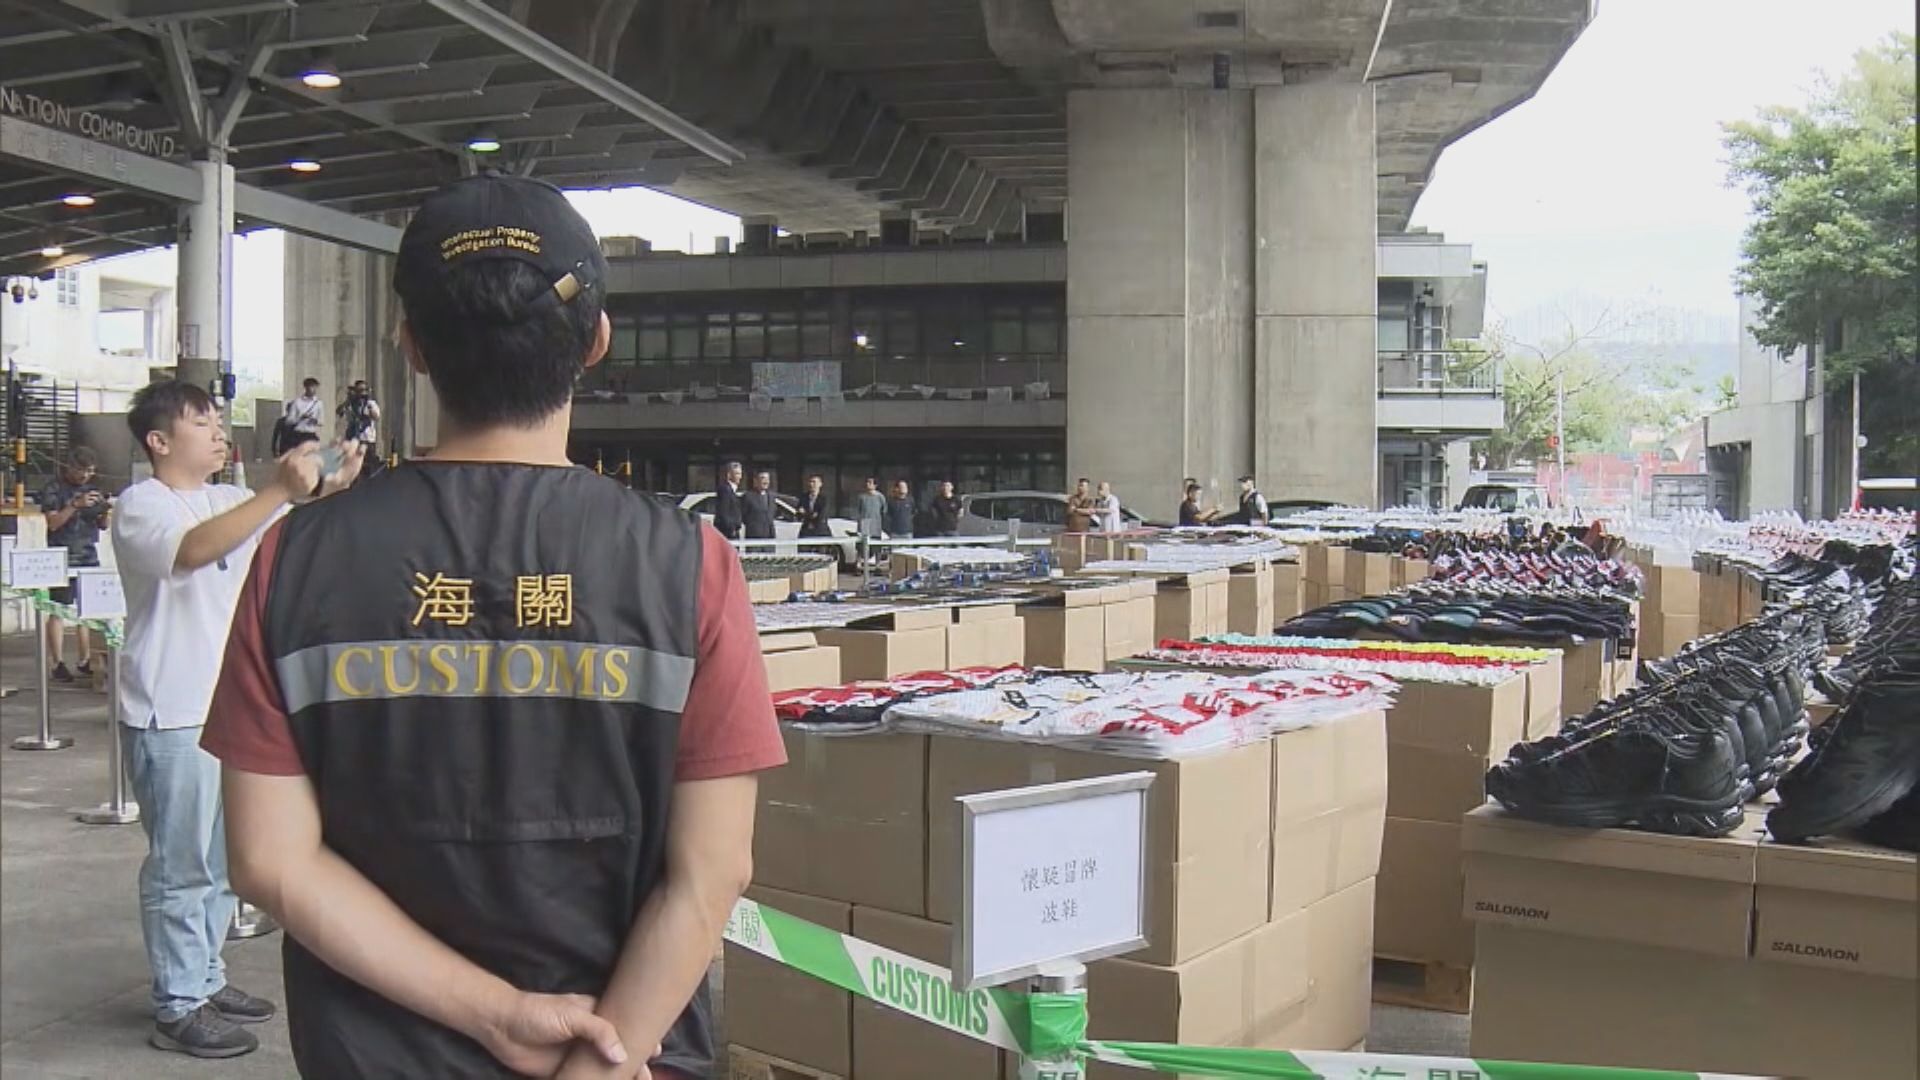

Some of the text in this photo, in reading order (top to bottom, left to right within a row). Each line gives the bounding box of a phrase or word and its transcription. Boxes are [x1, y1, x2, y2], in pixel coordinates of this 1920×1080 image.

[1, 86, 70, 128] NATION
[79, 112, 174, 157] COMPOUND
[180, 215, 192, 241] 4
[413, 572, 573, 627] 海關
[334, 643, 629, 698] CUSTOMS
[1021, 857, 1098, 892] 懷疑冒牌
[1041, 898, 1078, 923] 波鞋
[1475, 901, 1549, 920] SALOMON
[1771, 941, 1859, 962] SALOMON
[871, 956, 989, 1036] CUSTOMS
